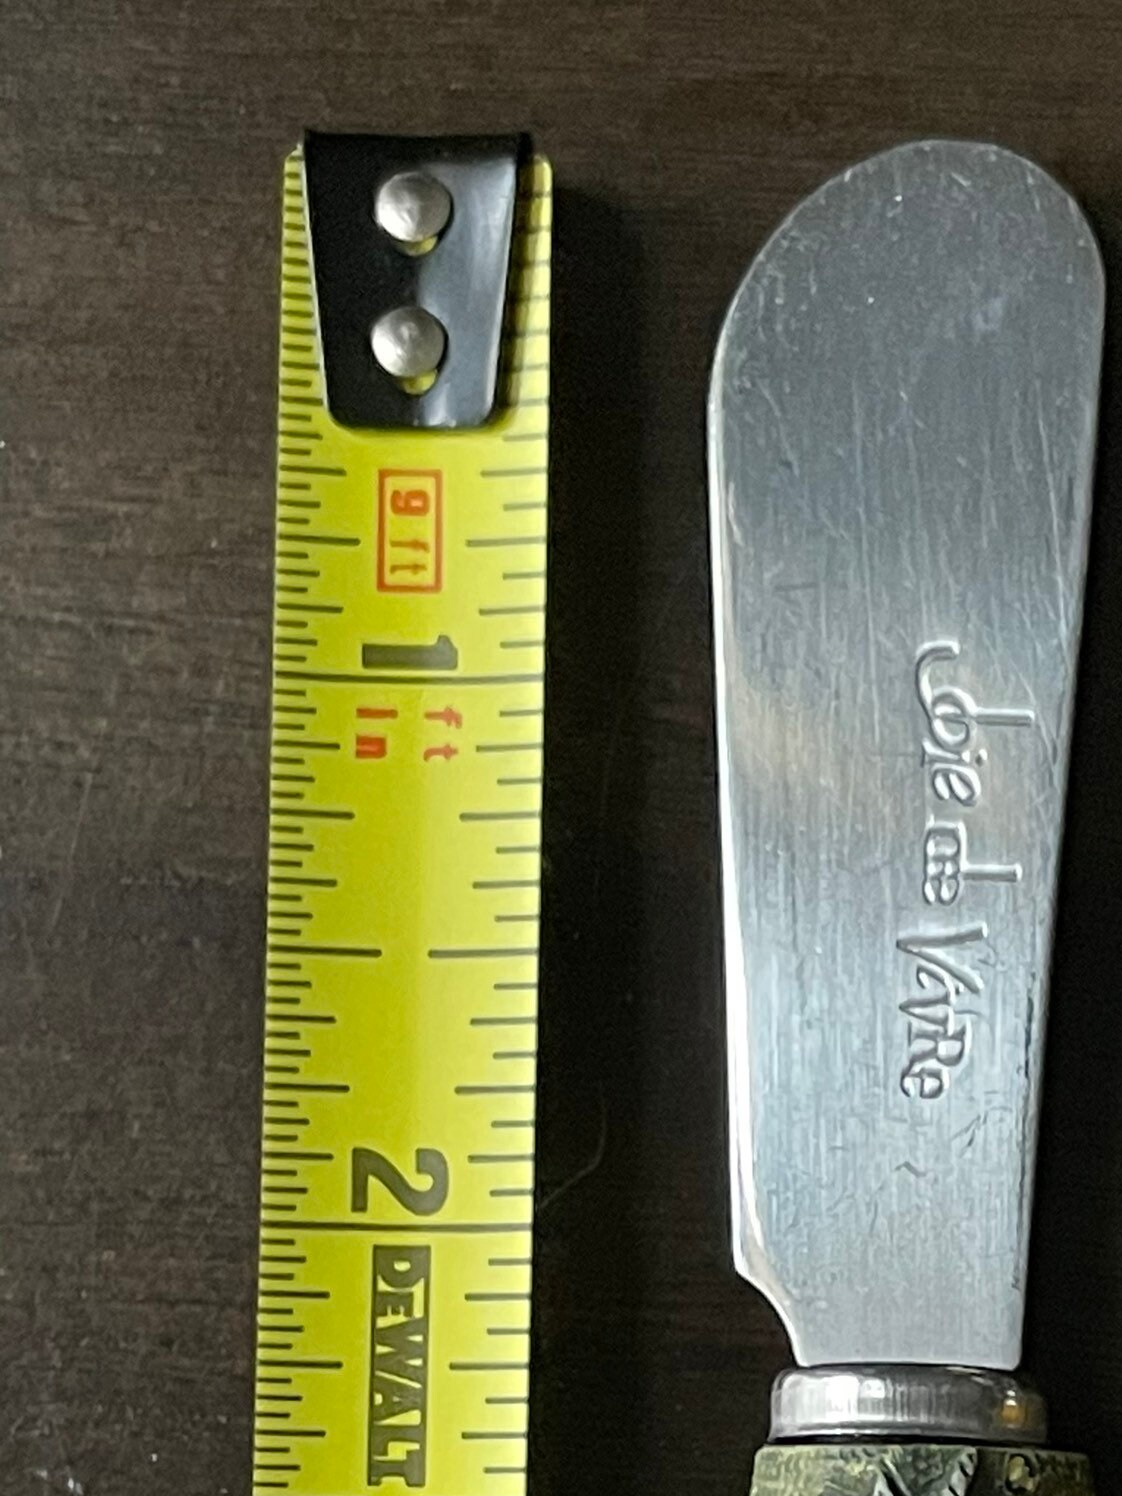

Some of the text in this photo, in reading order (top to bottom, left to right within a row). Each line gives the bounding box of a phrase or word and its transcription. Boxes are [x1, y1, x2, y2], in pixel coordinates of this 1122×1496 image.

[362, 634, 458, 669] 1
[356, 706, 398, 759] in
[423, 705, 463, 762] ft
[923, 819, 1024, 906] de
[353, 1147, 449, 1214] 2
[367, 1245, 431, 1486] DEWALT
